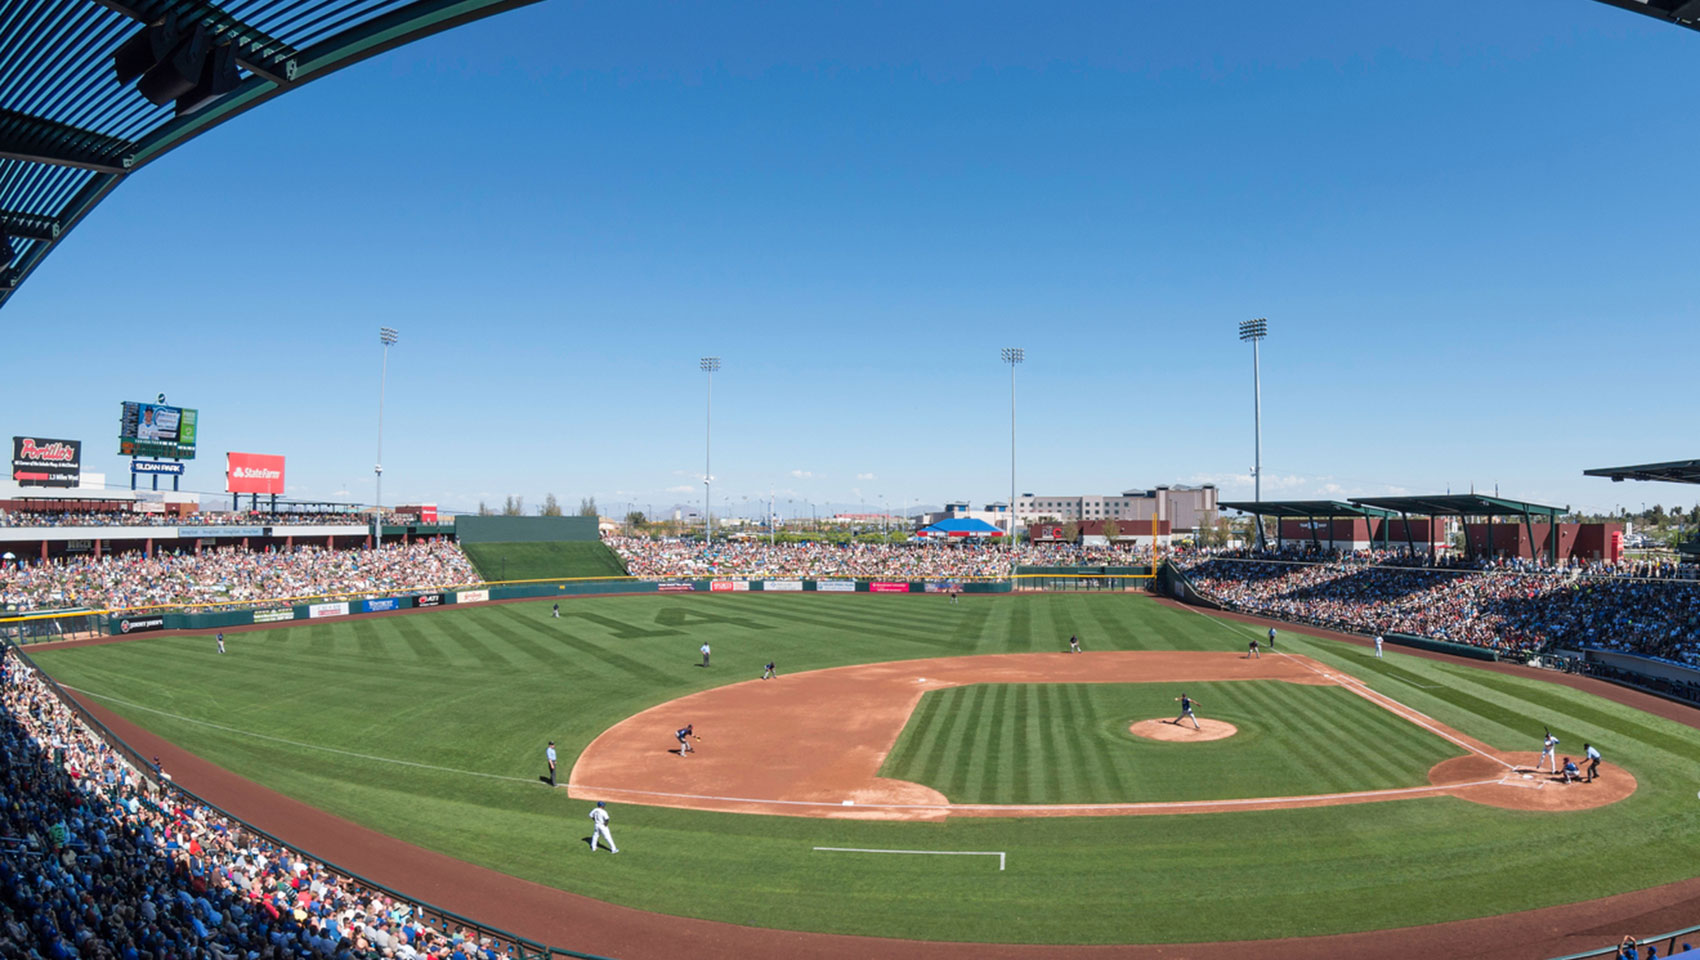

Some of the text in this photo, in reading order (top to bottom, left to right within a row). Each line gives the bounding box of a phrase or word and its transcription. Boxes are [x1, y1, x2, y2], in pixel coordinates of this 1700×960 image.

[21, 438, 75, 462] Portillo's
[135, 463, 180, 473] SLOAN PARK
[56, 473, 68, 481] Miles
[129, 620, 146, 629] JIMMY
